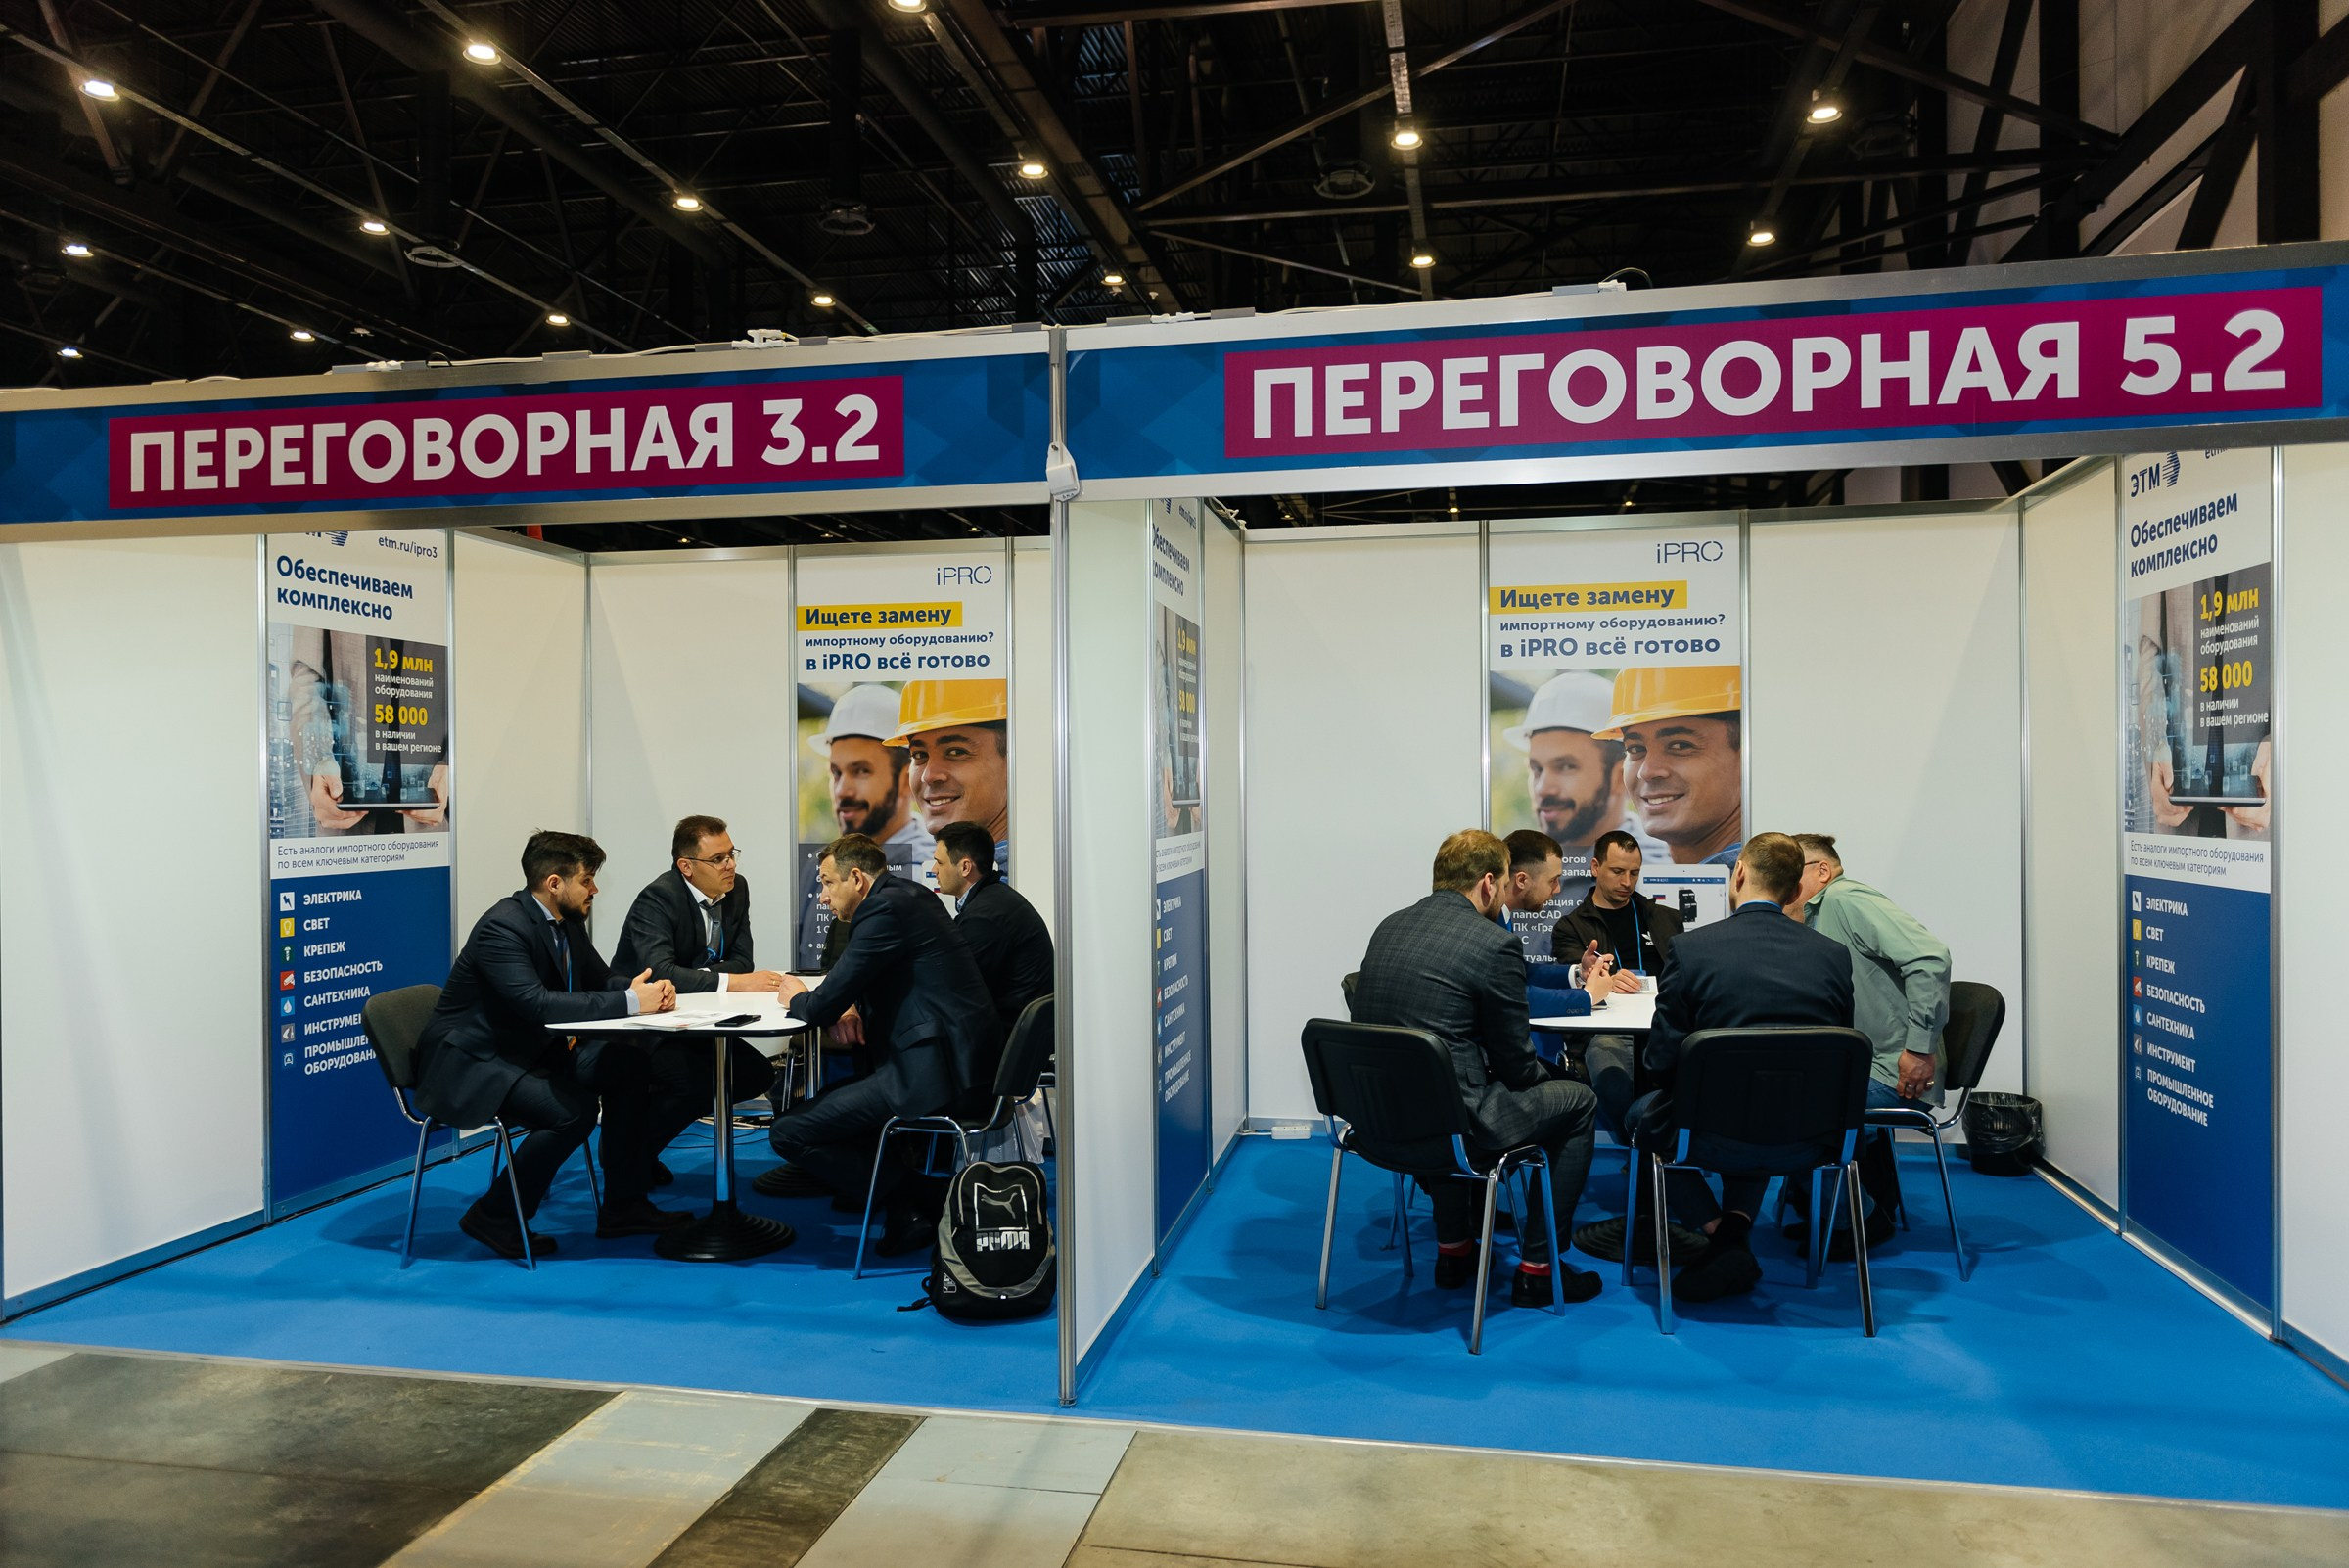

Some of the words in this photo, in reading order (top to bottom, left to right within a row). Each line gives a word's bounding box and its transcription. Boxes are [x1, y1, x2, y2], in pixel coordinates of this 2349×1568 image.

[1252, 321, 2079, 438] ПЕРЕГОВОРНАЯ
[2121, 310, 2285, 395] 5.2
[131, 403, 732, 491] ПЕРЕГОВОРНАЯ
[762, 394, 878, 465] 3.2
[2131, 462, 2160, 497] ЭТМ
[2131, 493, 2238, 548] Обеспечиваем
[378, 536, 438, 558] etm.ru/ipro3
[1656, 540, 1723, 564] iPRO
[2131, 534, 2218, 577] комплексно
[276, 555, 413, 599] Обеспечиваем
[937, 566, 992, 585] iPRO
[277, 587, 392, 620] комплексно
[1500, 589, 1580, 610] Ищете
[1587, 588, 1675, 607] замену
[2200, 591, 2223, 622] 1,9
[2227, 588, 2259, 614] млн
[806, 609, 872, 626] Ищете
[878, 608, 951, 625] замену
[1500, 619, 1595, 633] импортному
[1599, 614, 1725, 631] оборудованию?
[2200, 615, 2259, 639] наименований
[806, 636, 885, 648] импортному
[889, 632, 994, 646] оборудованию?
[1500, 644, 1513, 658] в
[1521, 637, 1578, 657] iPRO
[1586, 636, 1627, 656] всё
[1635, 638, 1721, 654] готово
[2200, 634, 2257, 656] оборудования
[374, 648, 398, 669] 1,9
[402, 656, 433, 672] млн
[806, 659, 816, 670] в
[822, 653, 871, 669] iPRO
[877, 652, 911, 669] всё
[918, 654, 990, 668] готово
[375, 673, 434, 687] наименований
[2200, 666, 2218, 692] 58
[2222, 660, 2253, 689] 000
[375, 685, 433, 699] оборудования
[375, 704, 393, 724] 58
[398, 706, 428, 725] 000
[2200, 702, 2204, 712] в
[2206, 697, 2239, 711] наличии
[2200, 717, 2204, 727] в
[2206, 715, 2232, 727] вашем
[2234, 712, 2269, 728] регионе
[382, 730, 415, 740] наличии
[411, 744, 441, 754] регионе
[278, 844, 298, 856] Есть
[299, 844, 335, 855] аналоги
[337, 842, 386, 853] импортного
[387, 840, 438, 852] оборудования
[2131, 840, 2142, 852] Есть
[2143, 844, 2167, 853] аналоги
[2168, 847, 2208, 859] импортного
[2209, 847, 2264, 863] оборудования
[278, 860, 290, 869] по
[292, 858, 314, 868] всем
[316, 857, 358, 867] ключевым
[360, 853, 405, 865] категориям
[2131, 856, 2138, 865] по
[2140, 858, 2152, 868] всем
[2154, 859, 2185, 871] ключевым
[2187, 862, 2227, 876] категориям
[303, 889, 362, 906] ЭЛЕКТРИКА
[2145, 897, 2188, 917] ЭЛЕКТРИКА
[303, 917, 330, 931] СВЕТ
[1513, 910, 1561, 919] nanoCAD
[1513, 923, 1528, 932] ПК
[2145, 926, 2164, 942] СВЕТ
[303, 941, 345, 957] КРЕПЕЖ
[303, 961, 384, 984] БЕЗОПАСНОСТЬ
[2146, 955, 2175, 975] КРЕПЕЖ
[303, 986, 370, 1008] САНТЕХНИКА
[2146, 984, 2205, 1014] БЕЗОПАСНОСТЬ
[304, 1013, 361, 1036] ИНСТРУМЕ
[2146, 1012, 2195, 1040] САНТЕХНИКА
[305, 1035, 369, 1058] ПРОМЫШЛЕ
[2147, 1042, 2196, 1073] ИНСТРУМЕНТ
[304, 1048, 377, 1076] ОБОРУДОВАН
[2147, 1068, 2214, 1109] ПРОМЫШЛЕННОЕ
[2147, 1087, 2208, 1127] ОБОРУДОВАНИЕ
[976, 1231, 1030, 1252] PUMA
